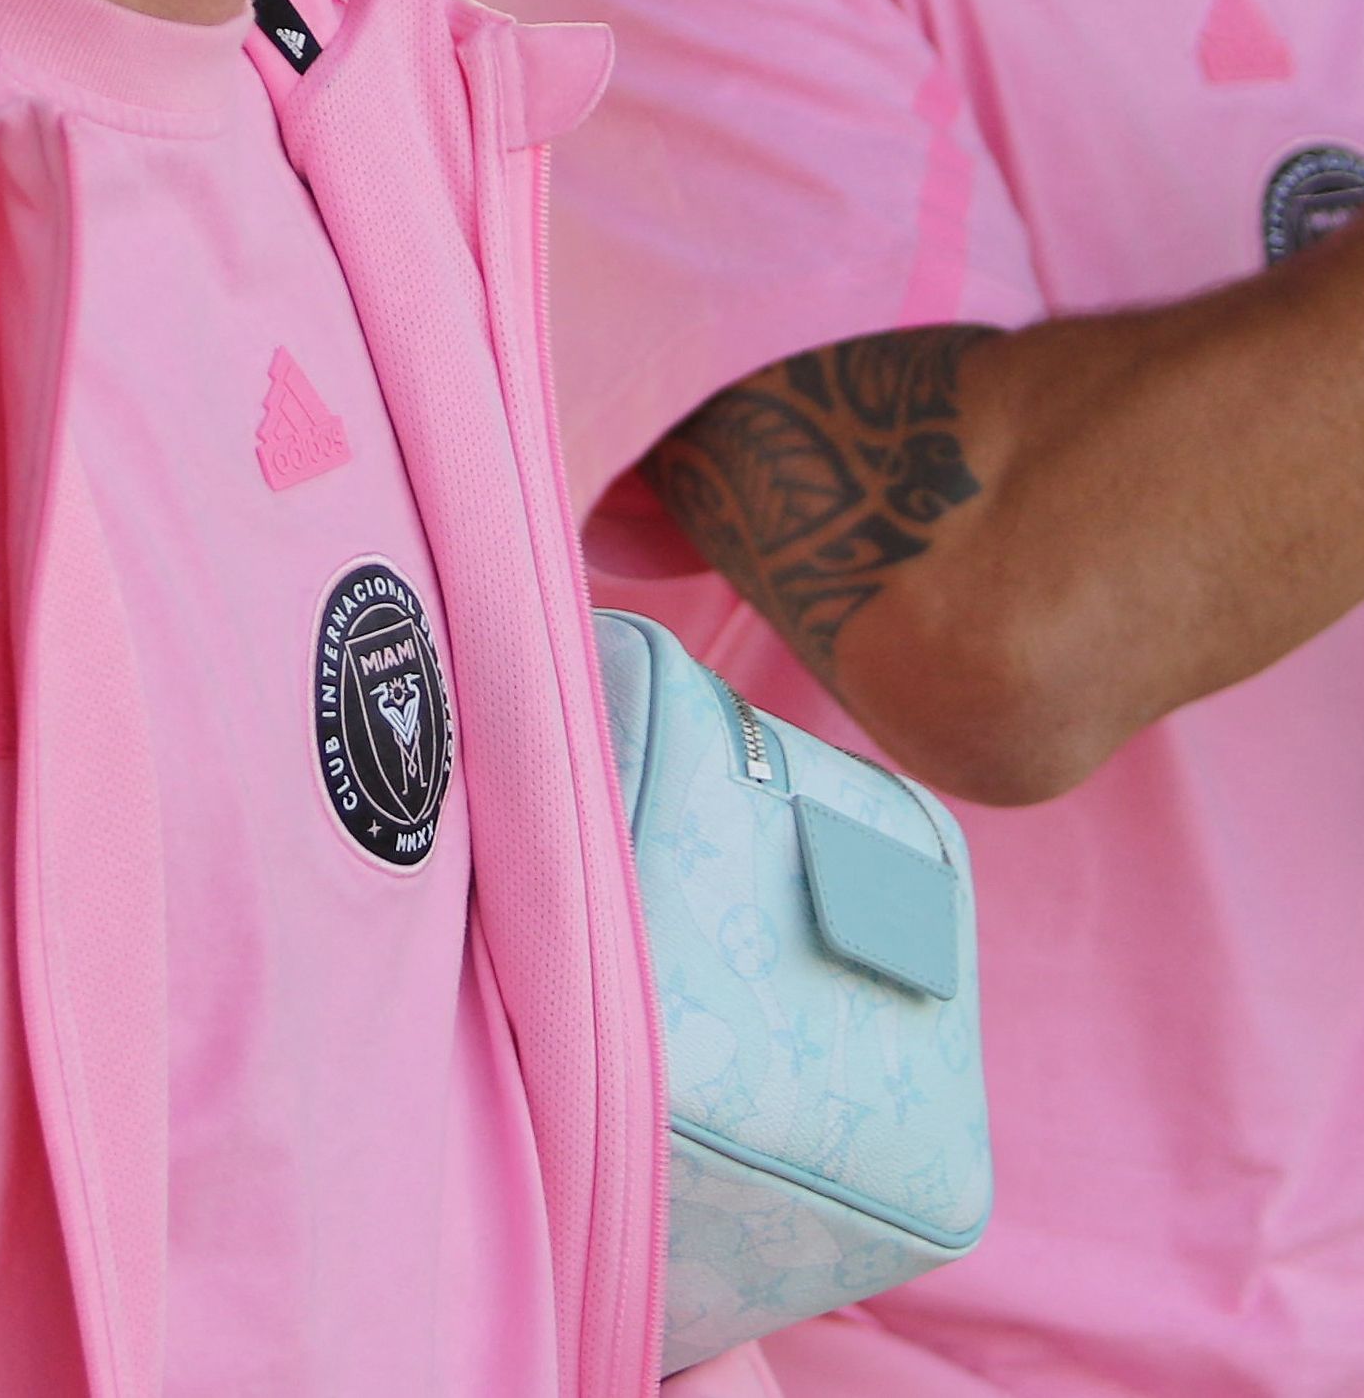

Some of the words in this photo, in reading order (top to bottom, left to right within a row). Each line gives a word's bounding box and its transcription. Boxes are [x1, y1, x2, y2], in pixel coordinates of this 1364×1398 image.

[272, 425, 343, 476] adidas
[322, 576, 416, 717] INTERNACIONAL
[358, 638, 416, 676] MIAMI
[325, 736, 358, 810] CLUB
